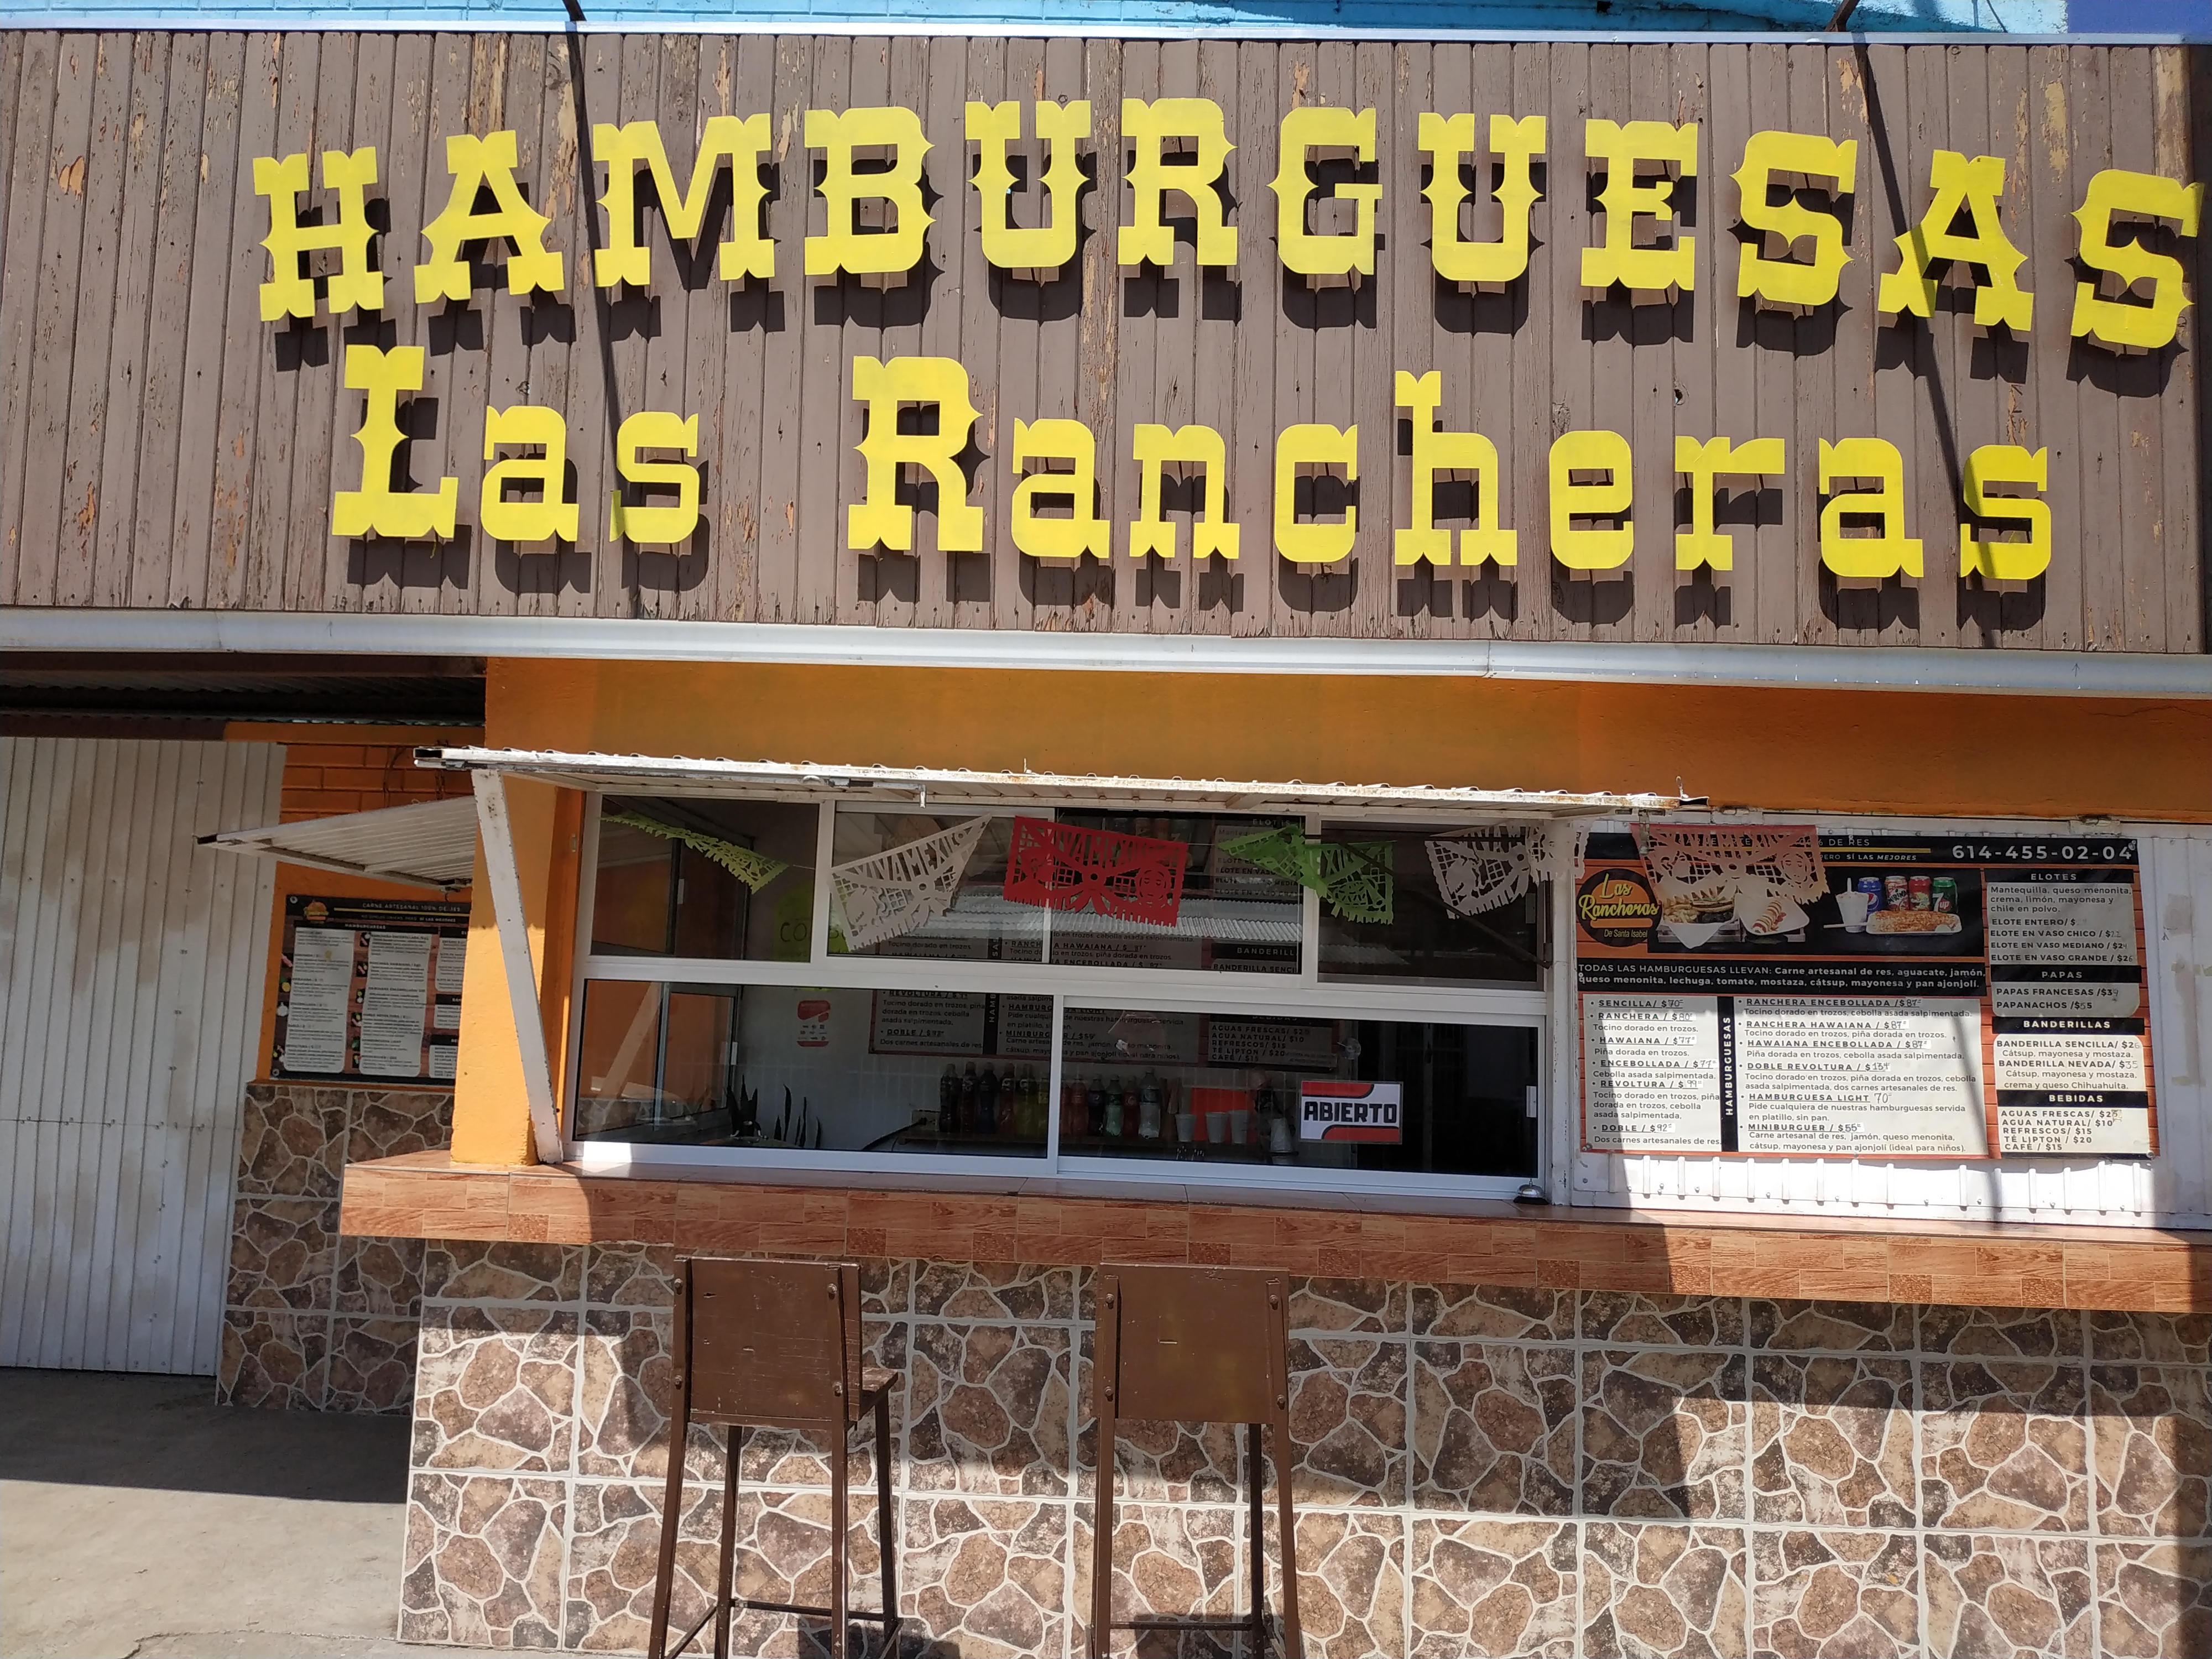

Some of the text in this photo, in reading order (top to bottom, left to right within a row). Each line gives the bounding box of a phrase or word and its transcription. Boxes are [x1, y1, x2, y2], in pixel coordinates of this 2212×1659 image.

[254, 99, 2199, 348] HAMBURGUESAS
[333, 345, 2051, 580] Las Rancheras
[1953, 845, 2131, 859] 614-455-02-04
[1600, 873, 1631, 899] Las
[1991, 886, 2049, 895] Mantequilla,
[1578, 894, 1661, 921] Rancheras
[1604, 929, 1648, 938] De Santa Isabel
[1578, 964, 1614, 973] TODAS
[1950, 968, 1987, 977] jamón,
[1578, 975, 1610, 984] queso
[1670, 977, 1713, 985] lechuga,
[1811, 979, 1848, 987] cátsup,
[1937, 980, 1979, 988] ajonjolí.
[2003, 1050, 2036, 1058] Cátsup,
[1723, 1018, 1734, 1115] HAMBURGUESAS
[2006, 1070, 2039, 1078] Cátsup,
[1304, 1101, 1397, 1123] ABIERTO
[1870, 1104, 1933, 1113] hamburguesas
[2005, 1142, 2033, 1150] CAFÉ
